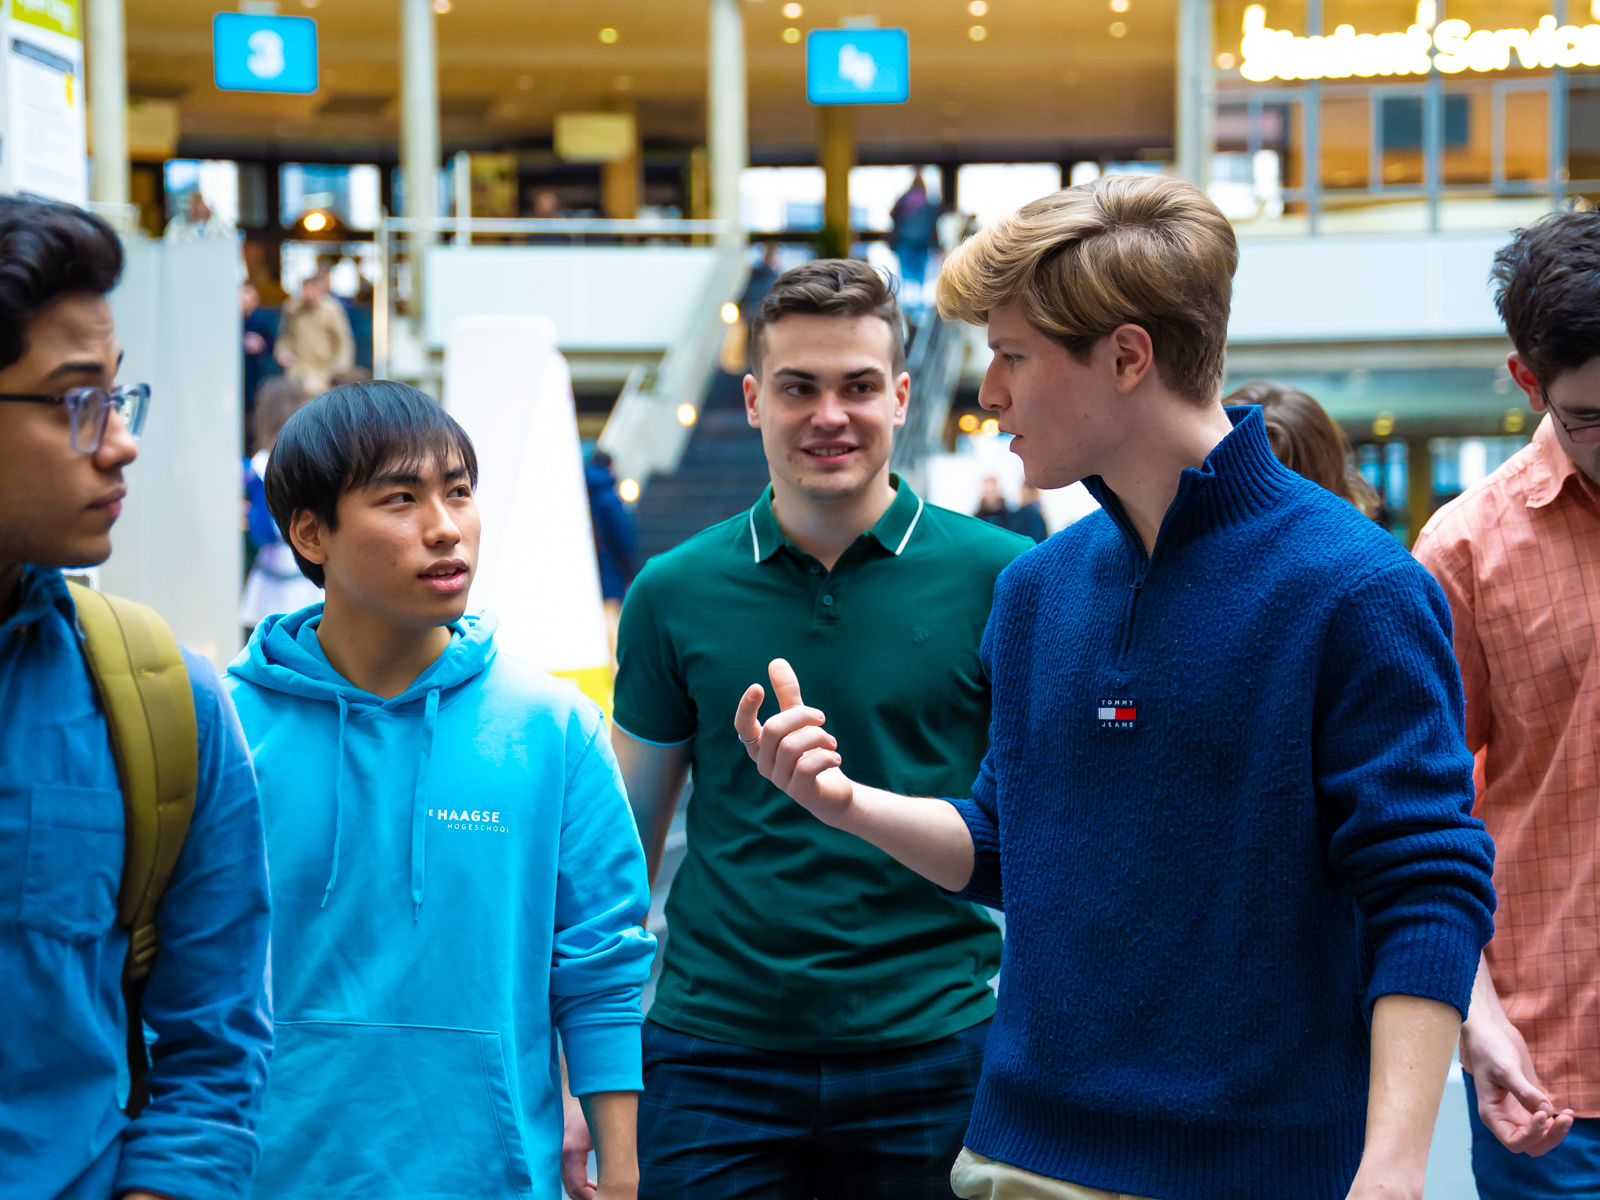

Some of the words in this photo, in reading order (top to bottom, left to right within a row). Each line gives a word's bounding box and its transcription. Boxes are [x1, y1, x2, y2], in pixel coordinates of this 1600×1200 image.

[247, 29, 285, 79] 3
[425, 808, 434, 817] E
[437, 809, 500, 823] HAAGSE
[447, 823, 510, 834] HOGESCHOOL
